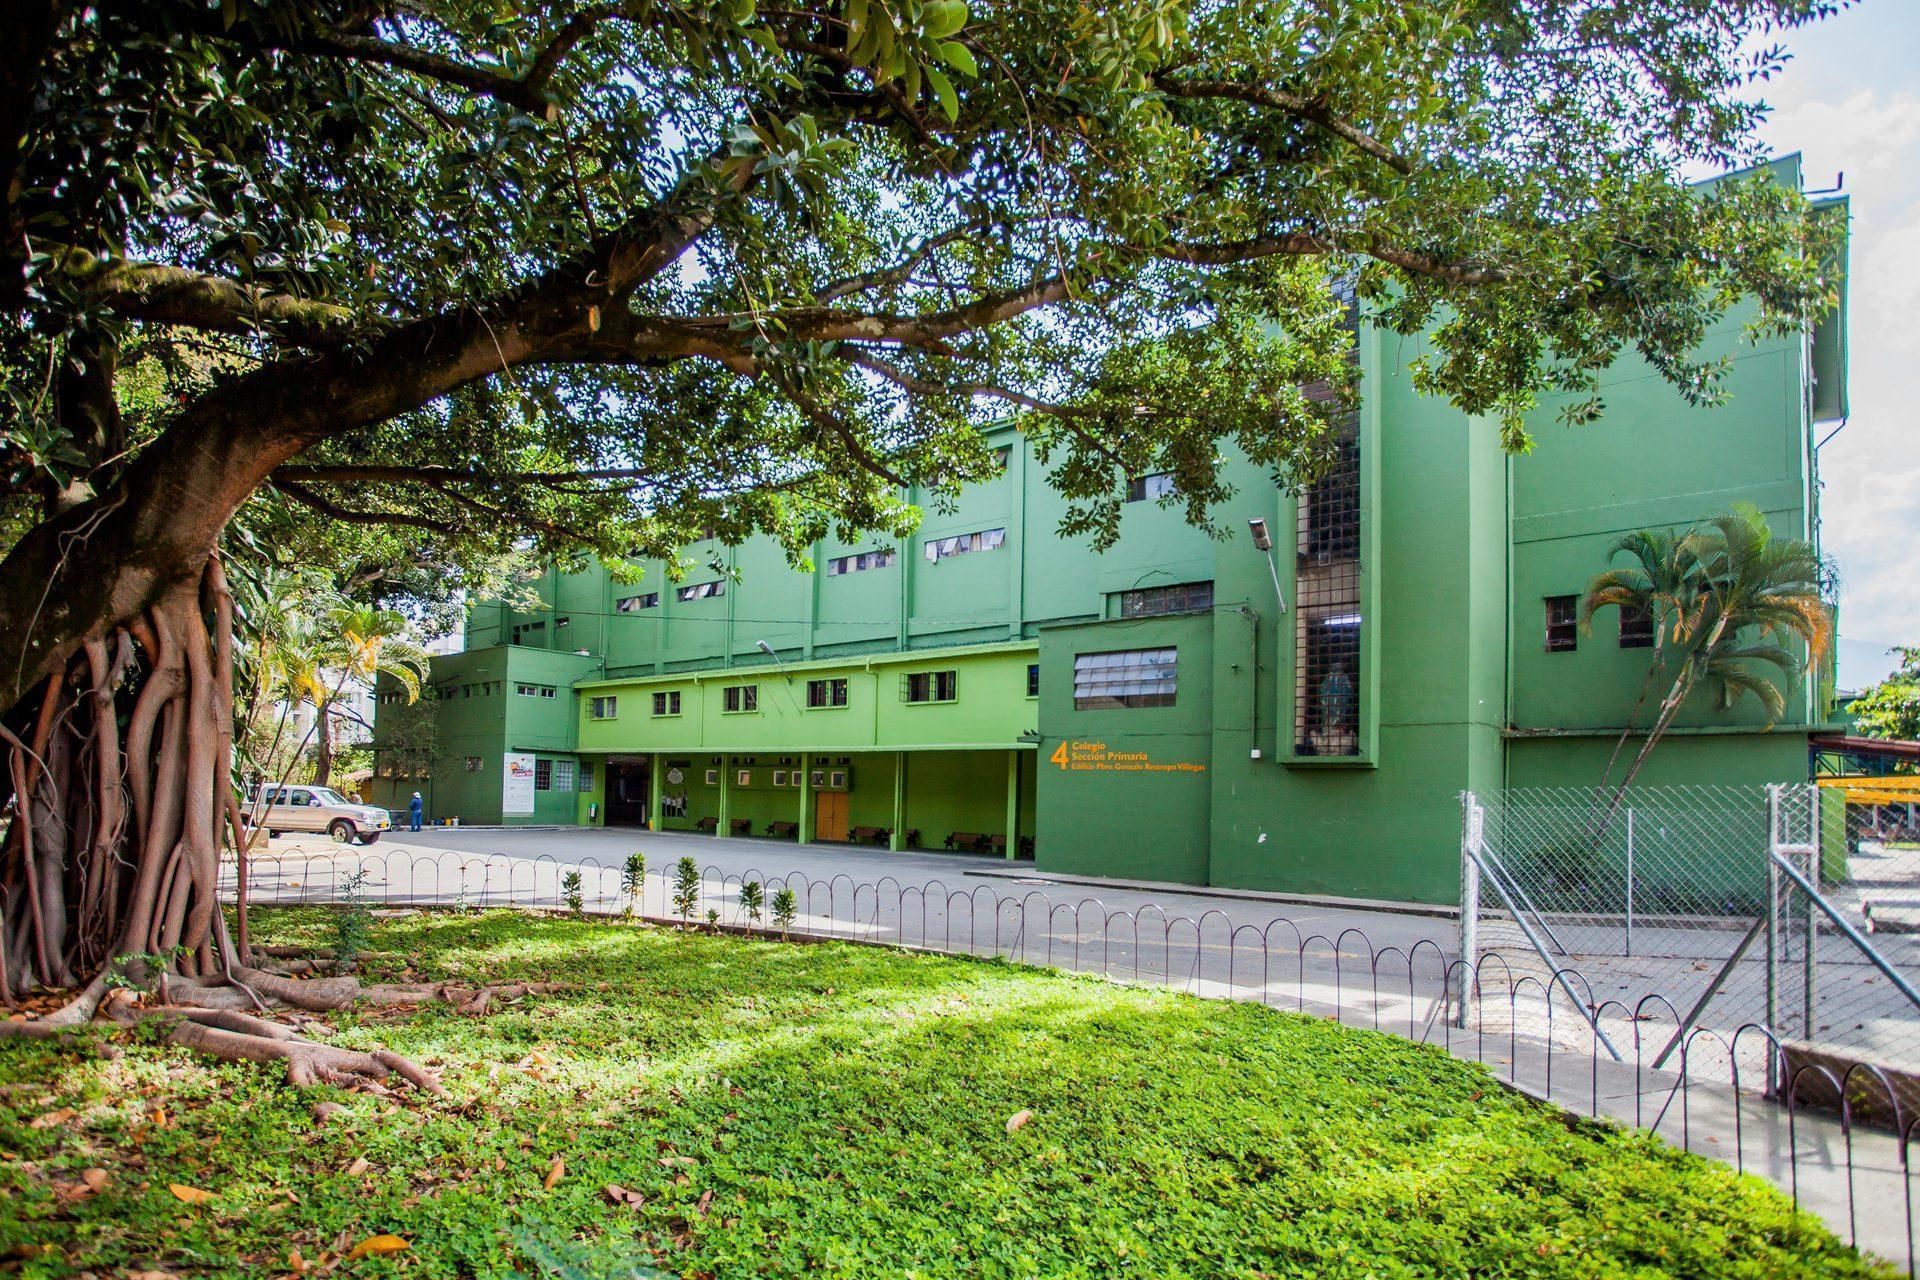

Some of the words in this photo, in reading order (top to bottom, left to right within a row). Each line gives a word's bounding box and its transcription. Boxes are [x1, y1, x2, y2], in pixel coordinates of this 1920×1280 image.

[1072, 741, 1106, 753] Colegio
[1051, 740, 1069, 770] 4
[1072, 751, 1105, 761] Sección
[1107, 752, 1148, 761] Primaria
